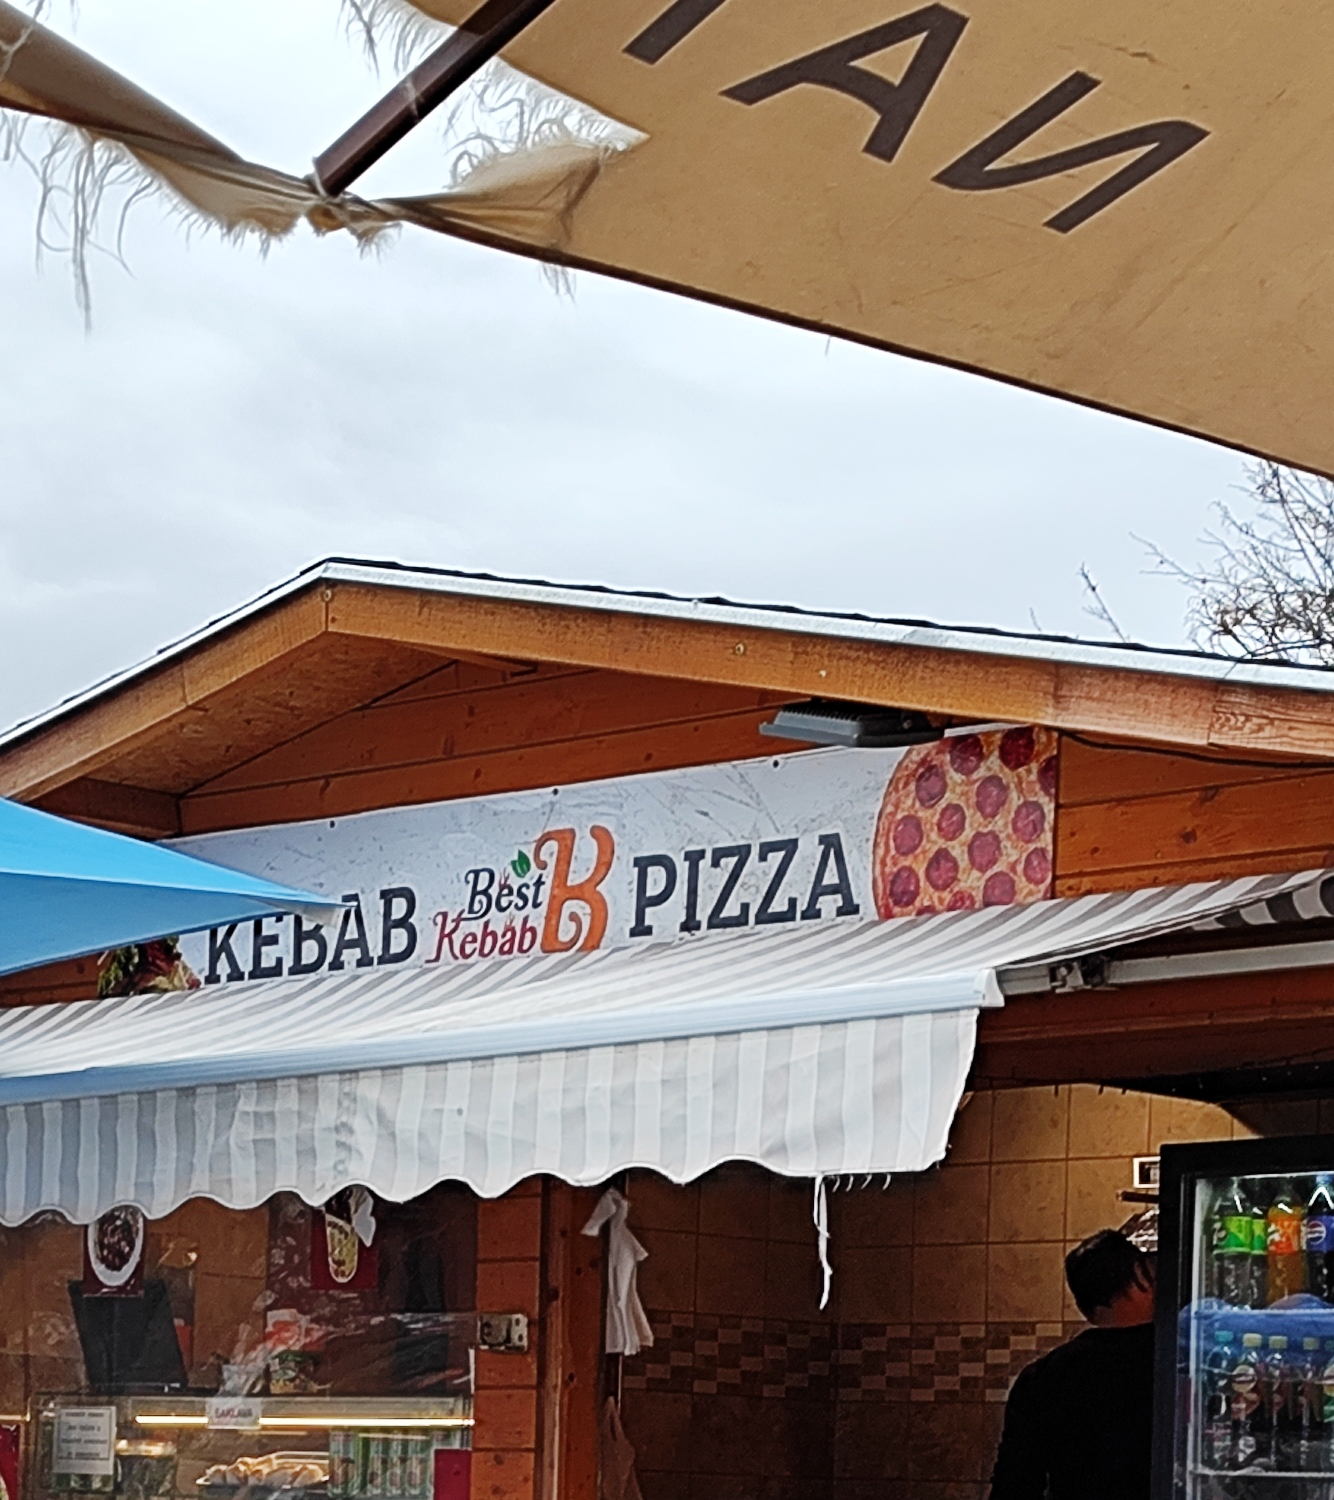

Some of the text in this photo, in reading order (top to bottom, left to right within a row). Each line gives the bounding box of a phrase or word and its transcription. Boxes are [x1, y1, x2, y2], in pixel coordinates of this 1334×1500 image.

[465, 867, 545, 920] Best
[629, 832, 862, 940] PIZZA
[205, 886, 417, 984] KEBAB
[425, 909, 537, 963] Kebab
